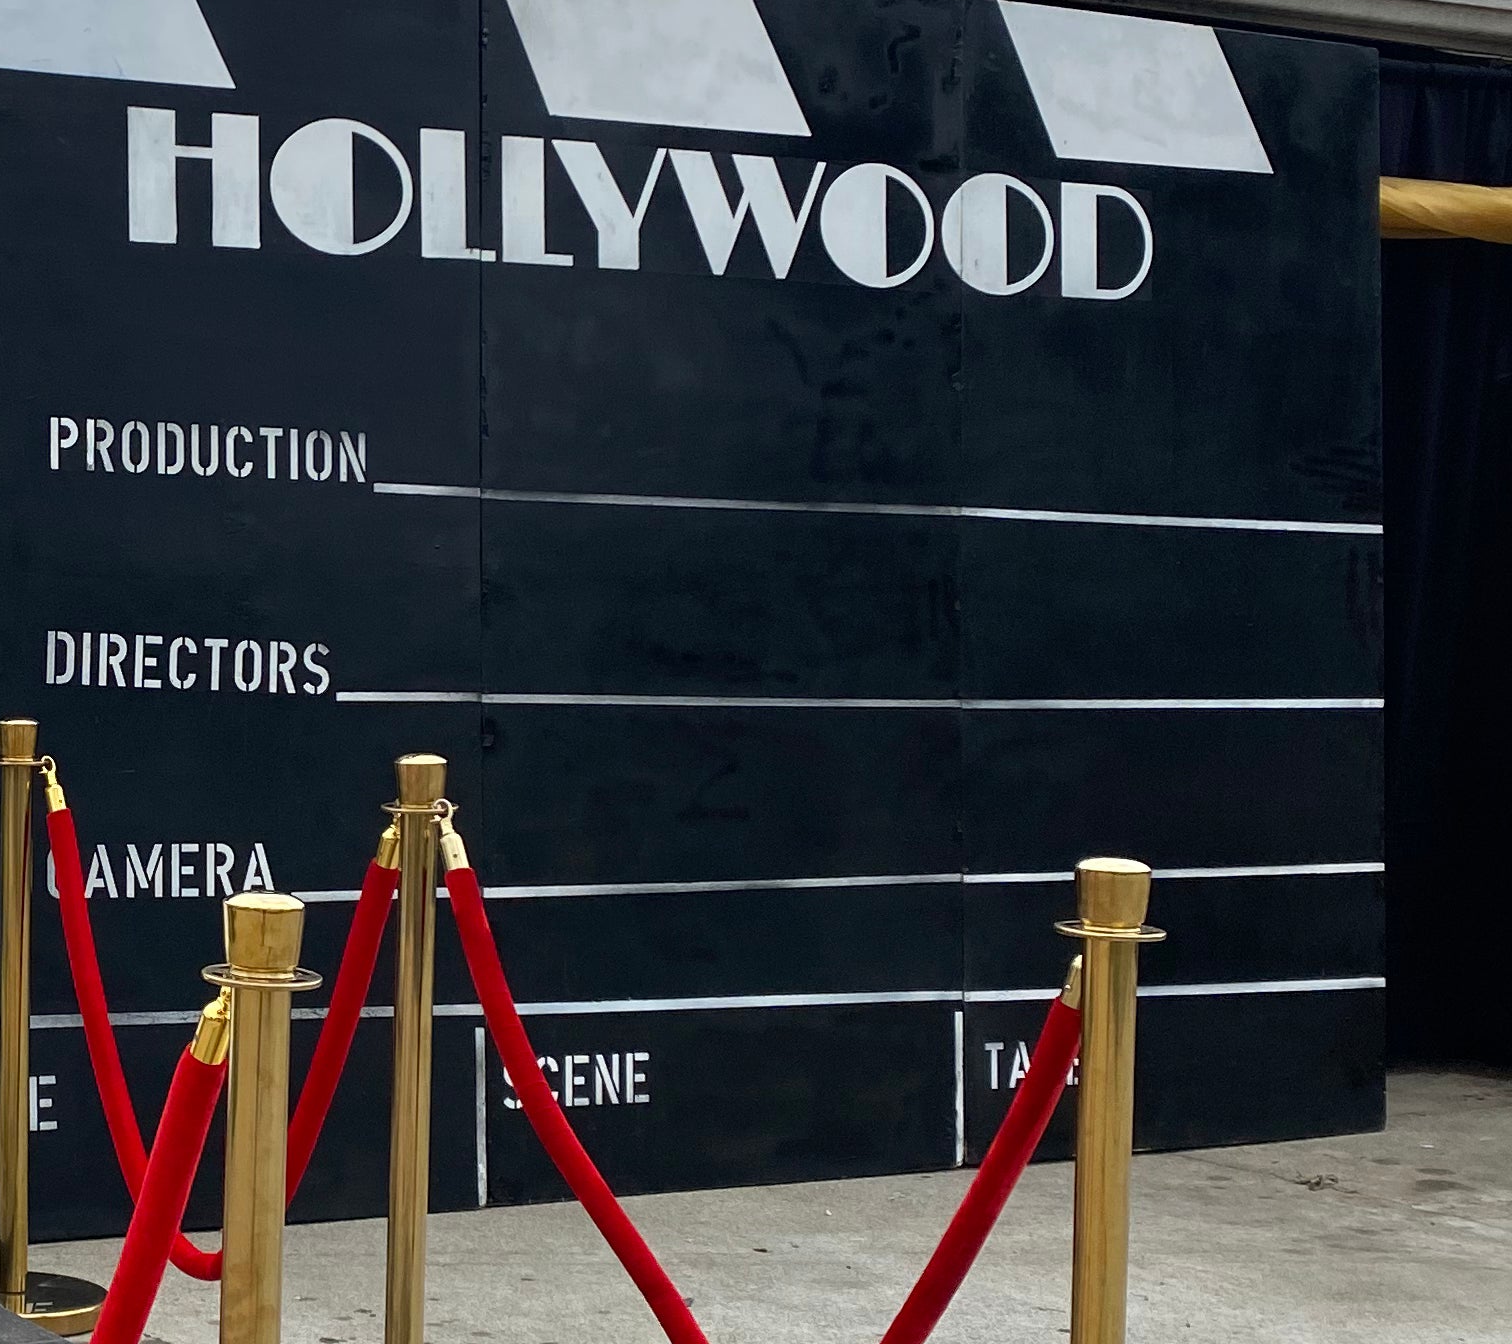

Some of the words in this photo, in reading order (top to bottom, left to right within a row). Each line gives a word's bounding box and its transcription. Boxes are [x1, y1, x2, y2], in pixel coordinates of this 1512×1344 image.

[127, 105, 1154, 300] HOLLYWOOD
[50, 416, 367, 483] PRODUCTION
[45, 630, 331, 695] DIRECTORS
[984, 1040, 1080, 1090] TA
